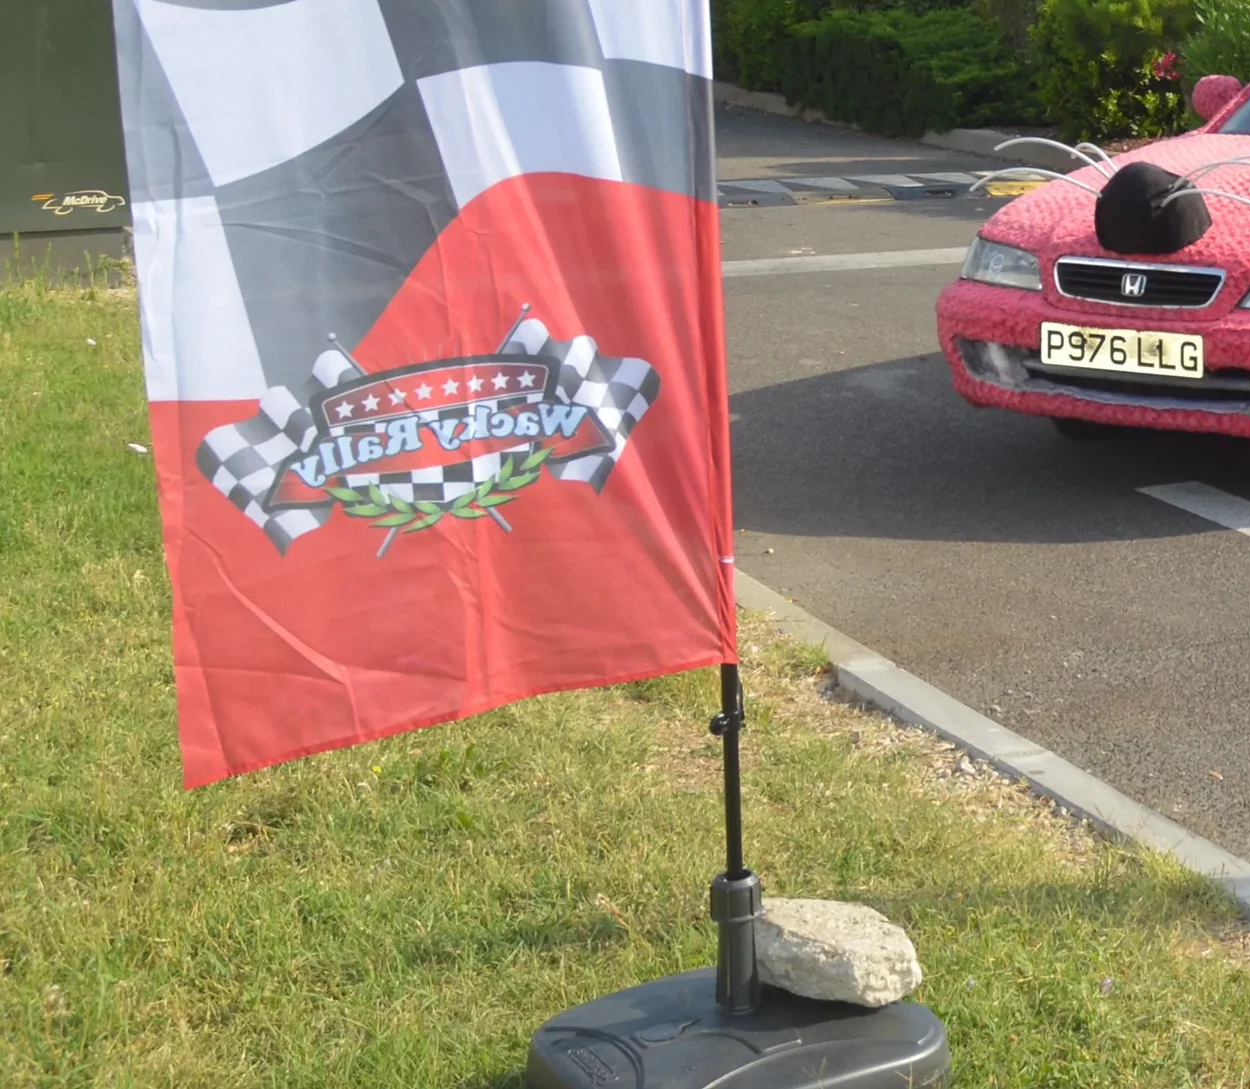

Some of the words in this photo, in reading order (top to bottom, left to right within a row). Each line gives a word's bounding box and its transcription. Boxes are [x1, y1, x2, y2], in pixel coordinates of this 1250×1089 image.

[62, 195, 108, 206] McDrive
[1047, 330, 1127, 365] P976
[1137, 337, 1198, 371] LLG
